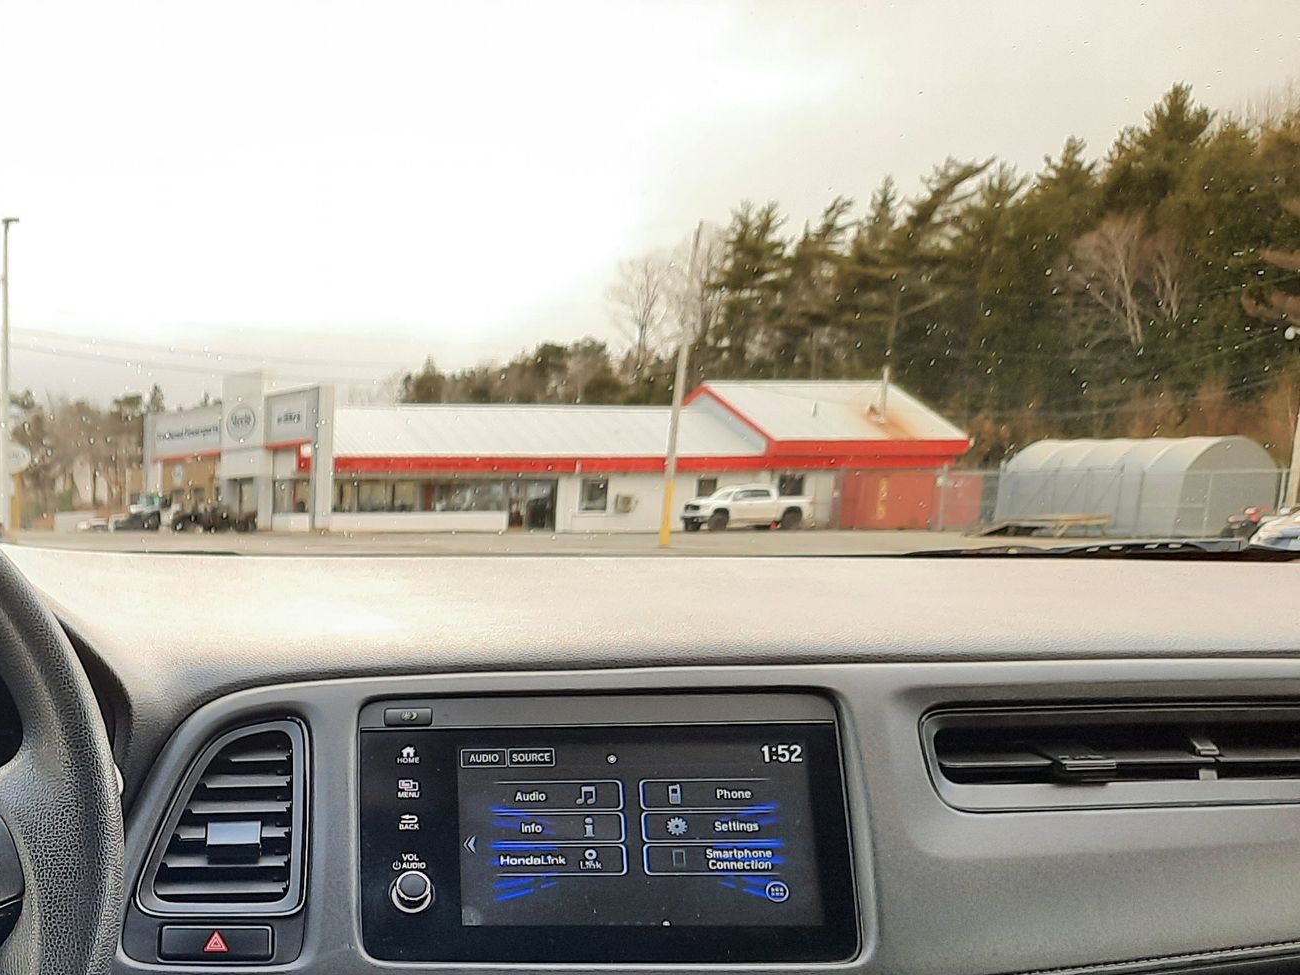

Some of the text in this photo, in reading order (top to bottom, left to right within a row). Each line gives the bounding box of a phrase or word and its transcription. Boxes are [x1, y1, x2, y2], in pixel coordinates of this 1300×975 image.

[469, 754, 500, 763] AUDIO
[511, 753, 551, 763] SOURCE
[761, 745, 803, 763] 1:52
[397, 791, 421, 799] MENU
[515, 791, 547, 802] Audio
[716, 789, 752, 800] Phone
[399, 823, 420, 831] BACK
[521, 823, 543, 834] Info
[714, 822, 760, 833] Settings
[401, 854, 420, 862] VOL
[705, 849, 773, 860] Smartphone
[402, 862, 427, 870] AUDIO
[499, 855, 567, 866] HondaLink
[708, 860, 772, 871] Connection
